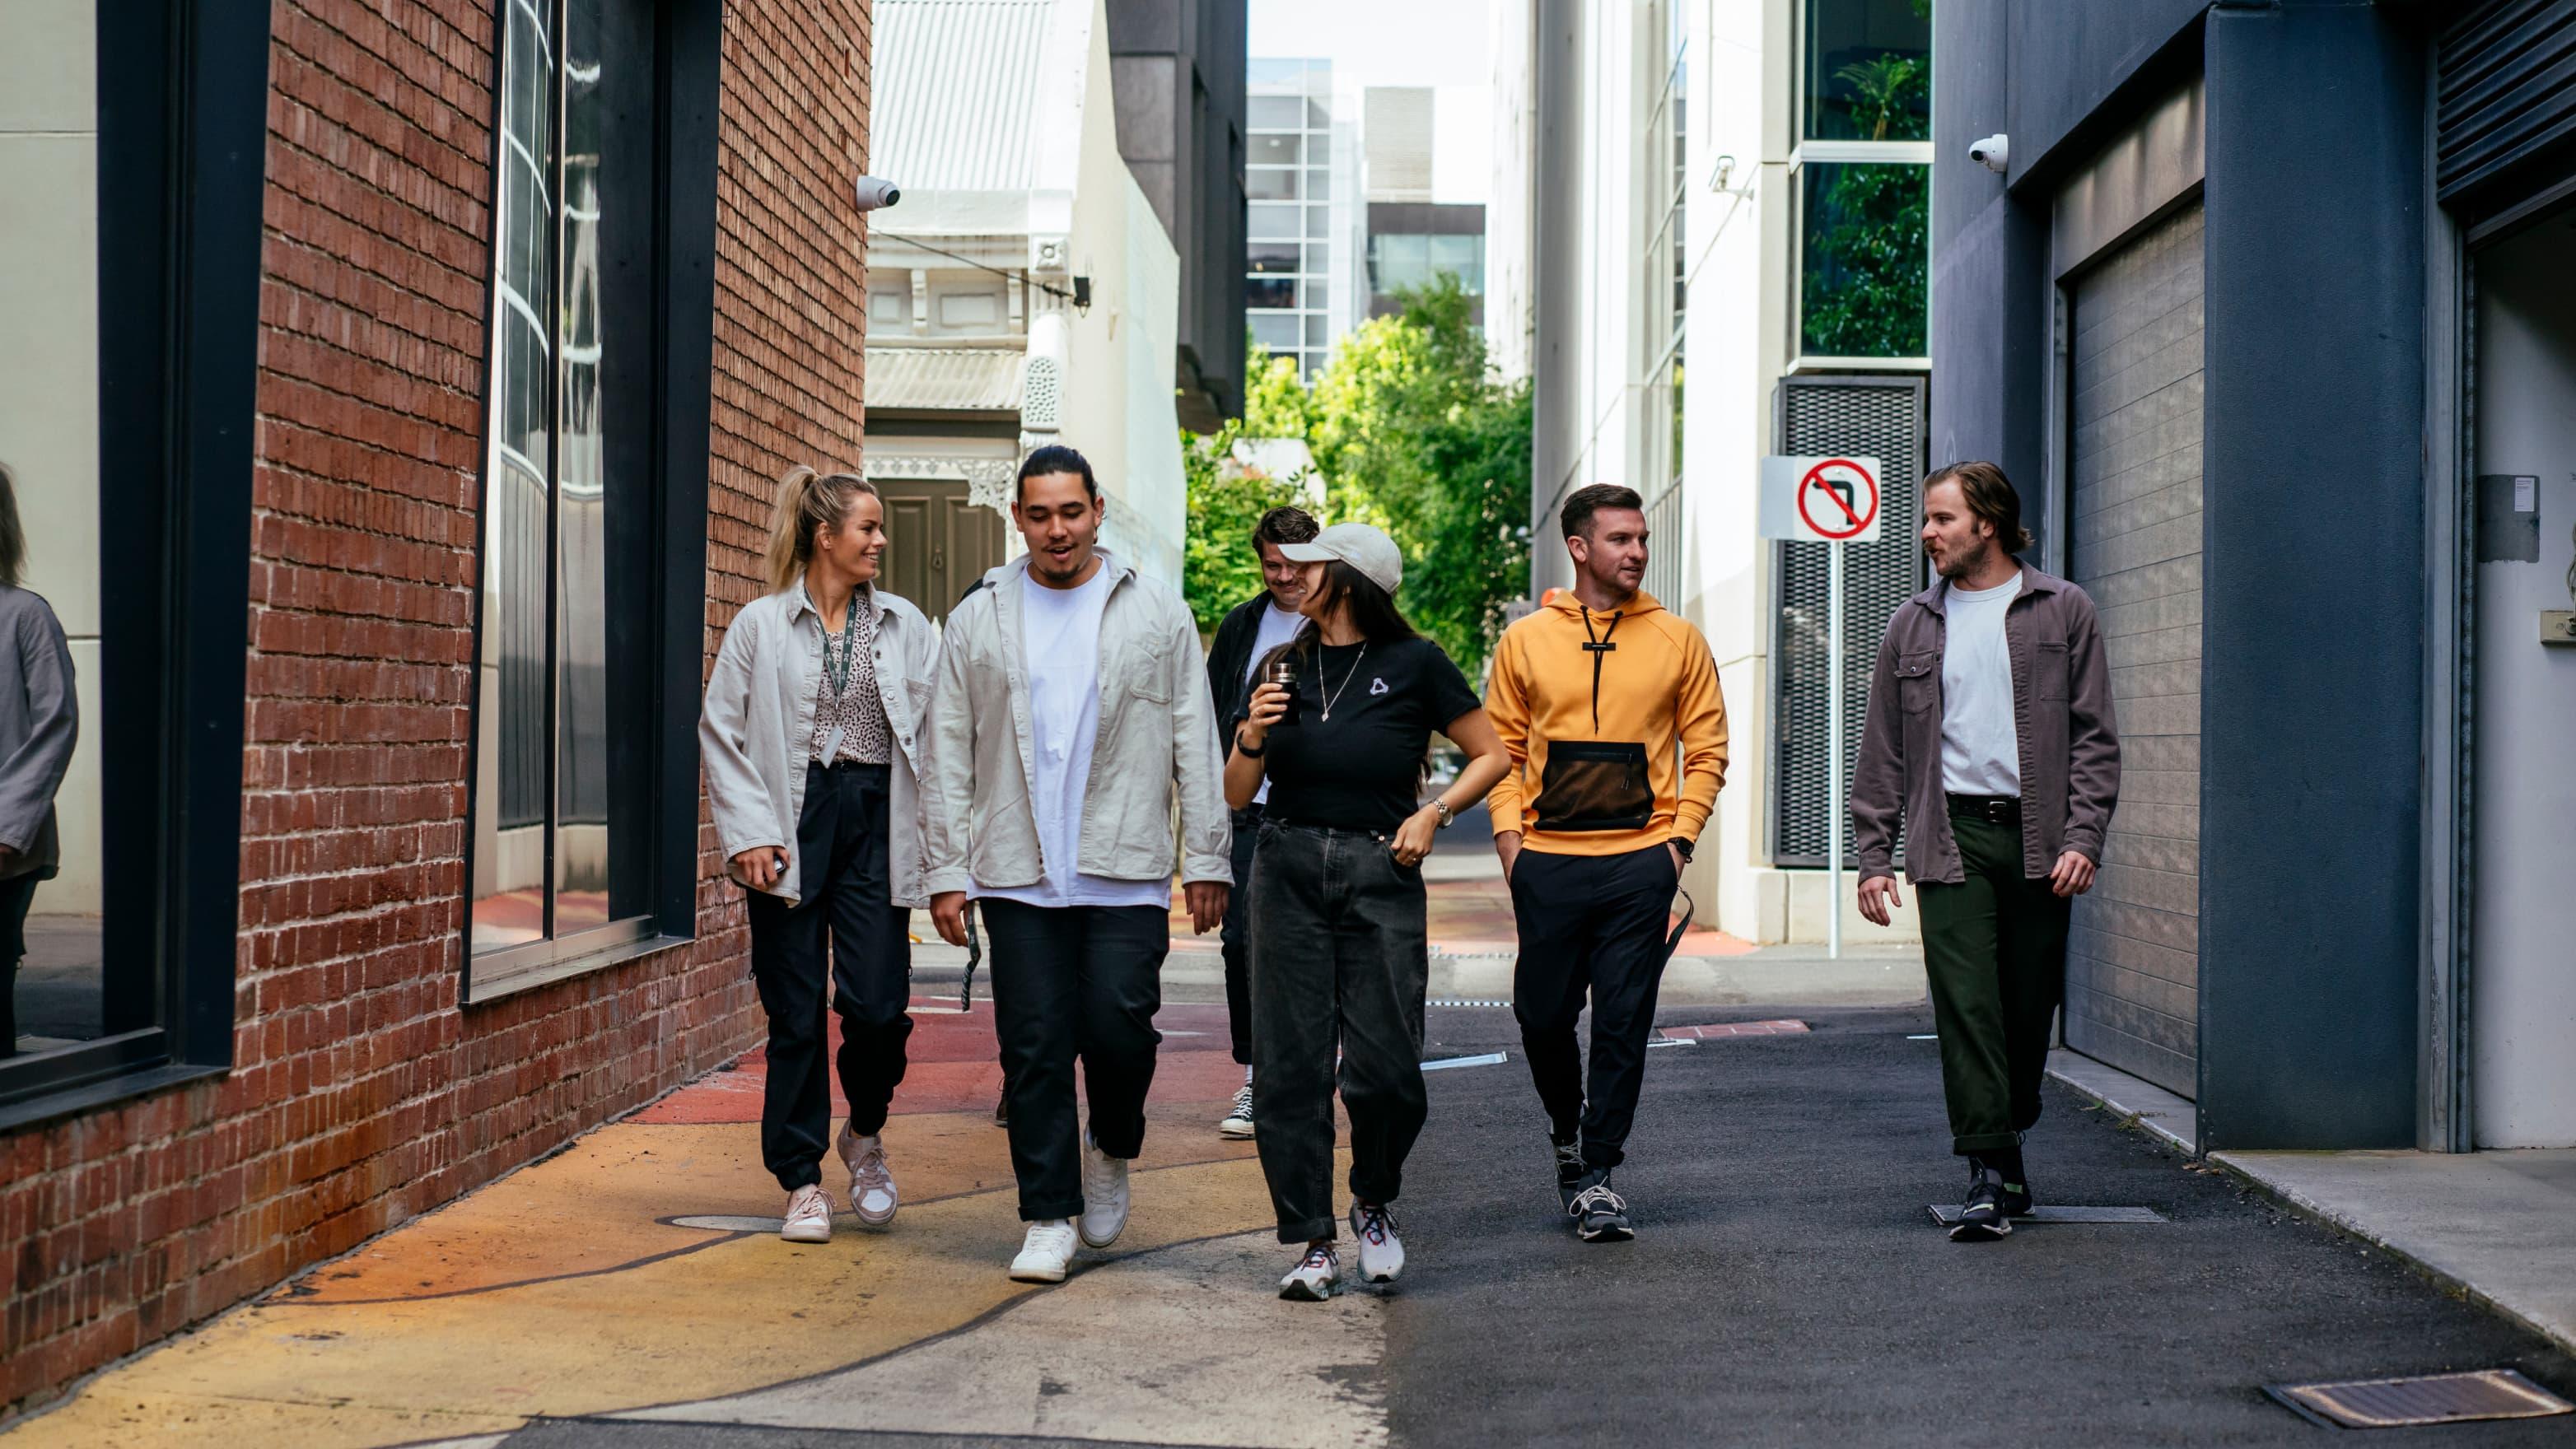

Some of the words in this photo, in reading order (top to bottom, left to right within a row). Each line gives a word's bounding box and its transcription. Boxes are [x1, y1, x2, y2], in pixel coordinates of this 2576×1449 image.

[848, 620, 854, 629] DC
[846, 636, 852, 645] DC
[825, 652, 832, 661] DC
[843, 653, 849, 662] DC
